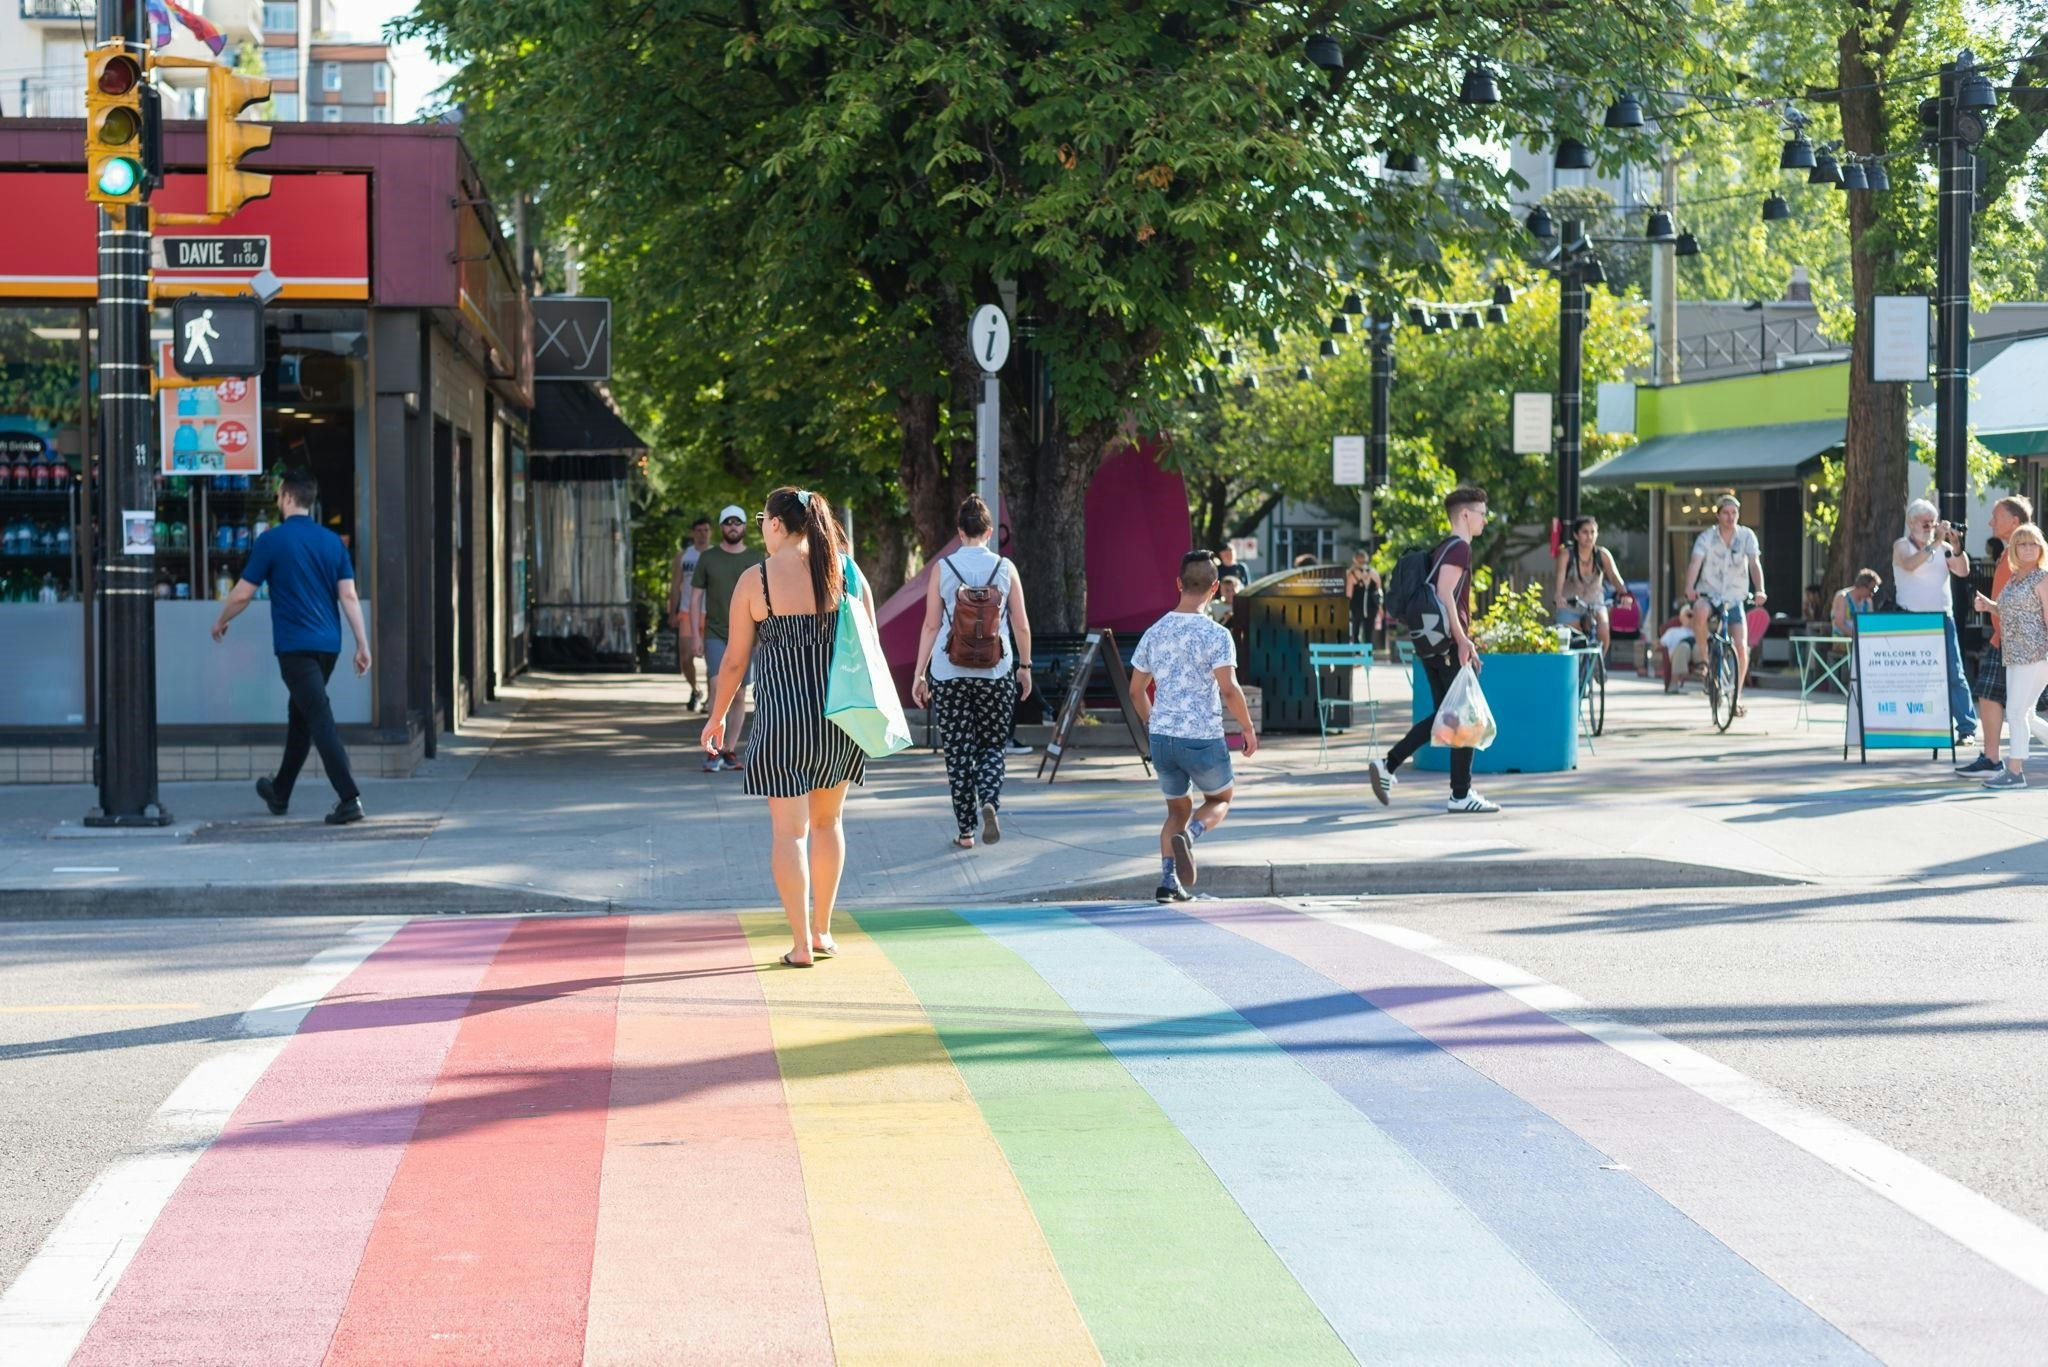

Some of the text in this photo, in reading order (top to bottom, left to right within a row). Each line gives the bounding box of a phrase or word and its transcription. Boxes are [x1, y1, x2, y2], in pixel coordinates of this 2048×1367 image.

[179, 242, 252, 264] DAVIE ST
[233, 253, 259, 264] 1100
[1868, 659, 1881, 667] JIM
